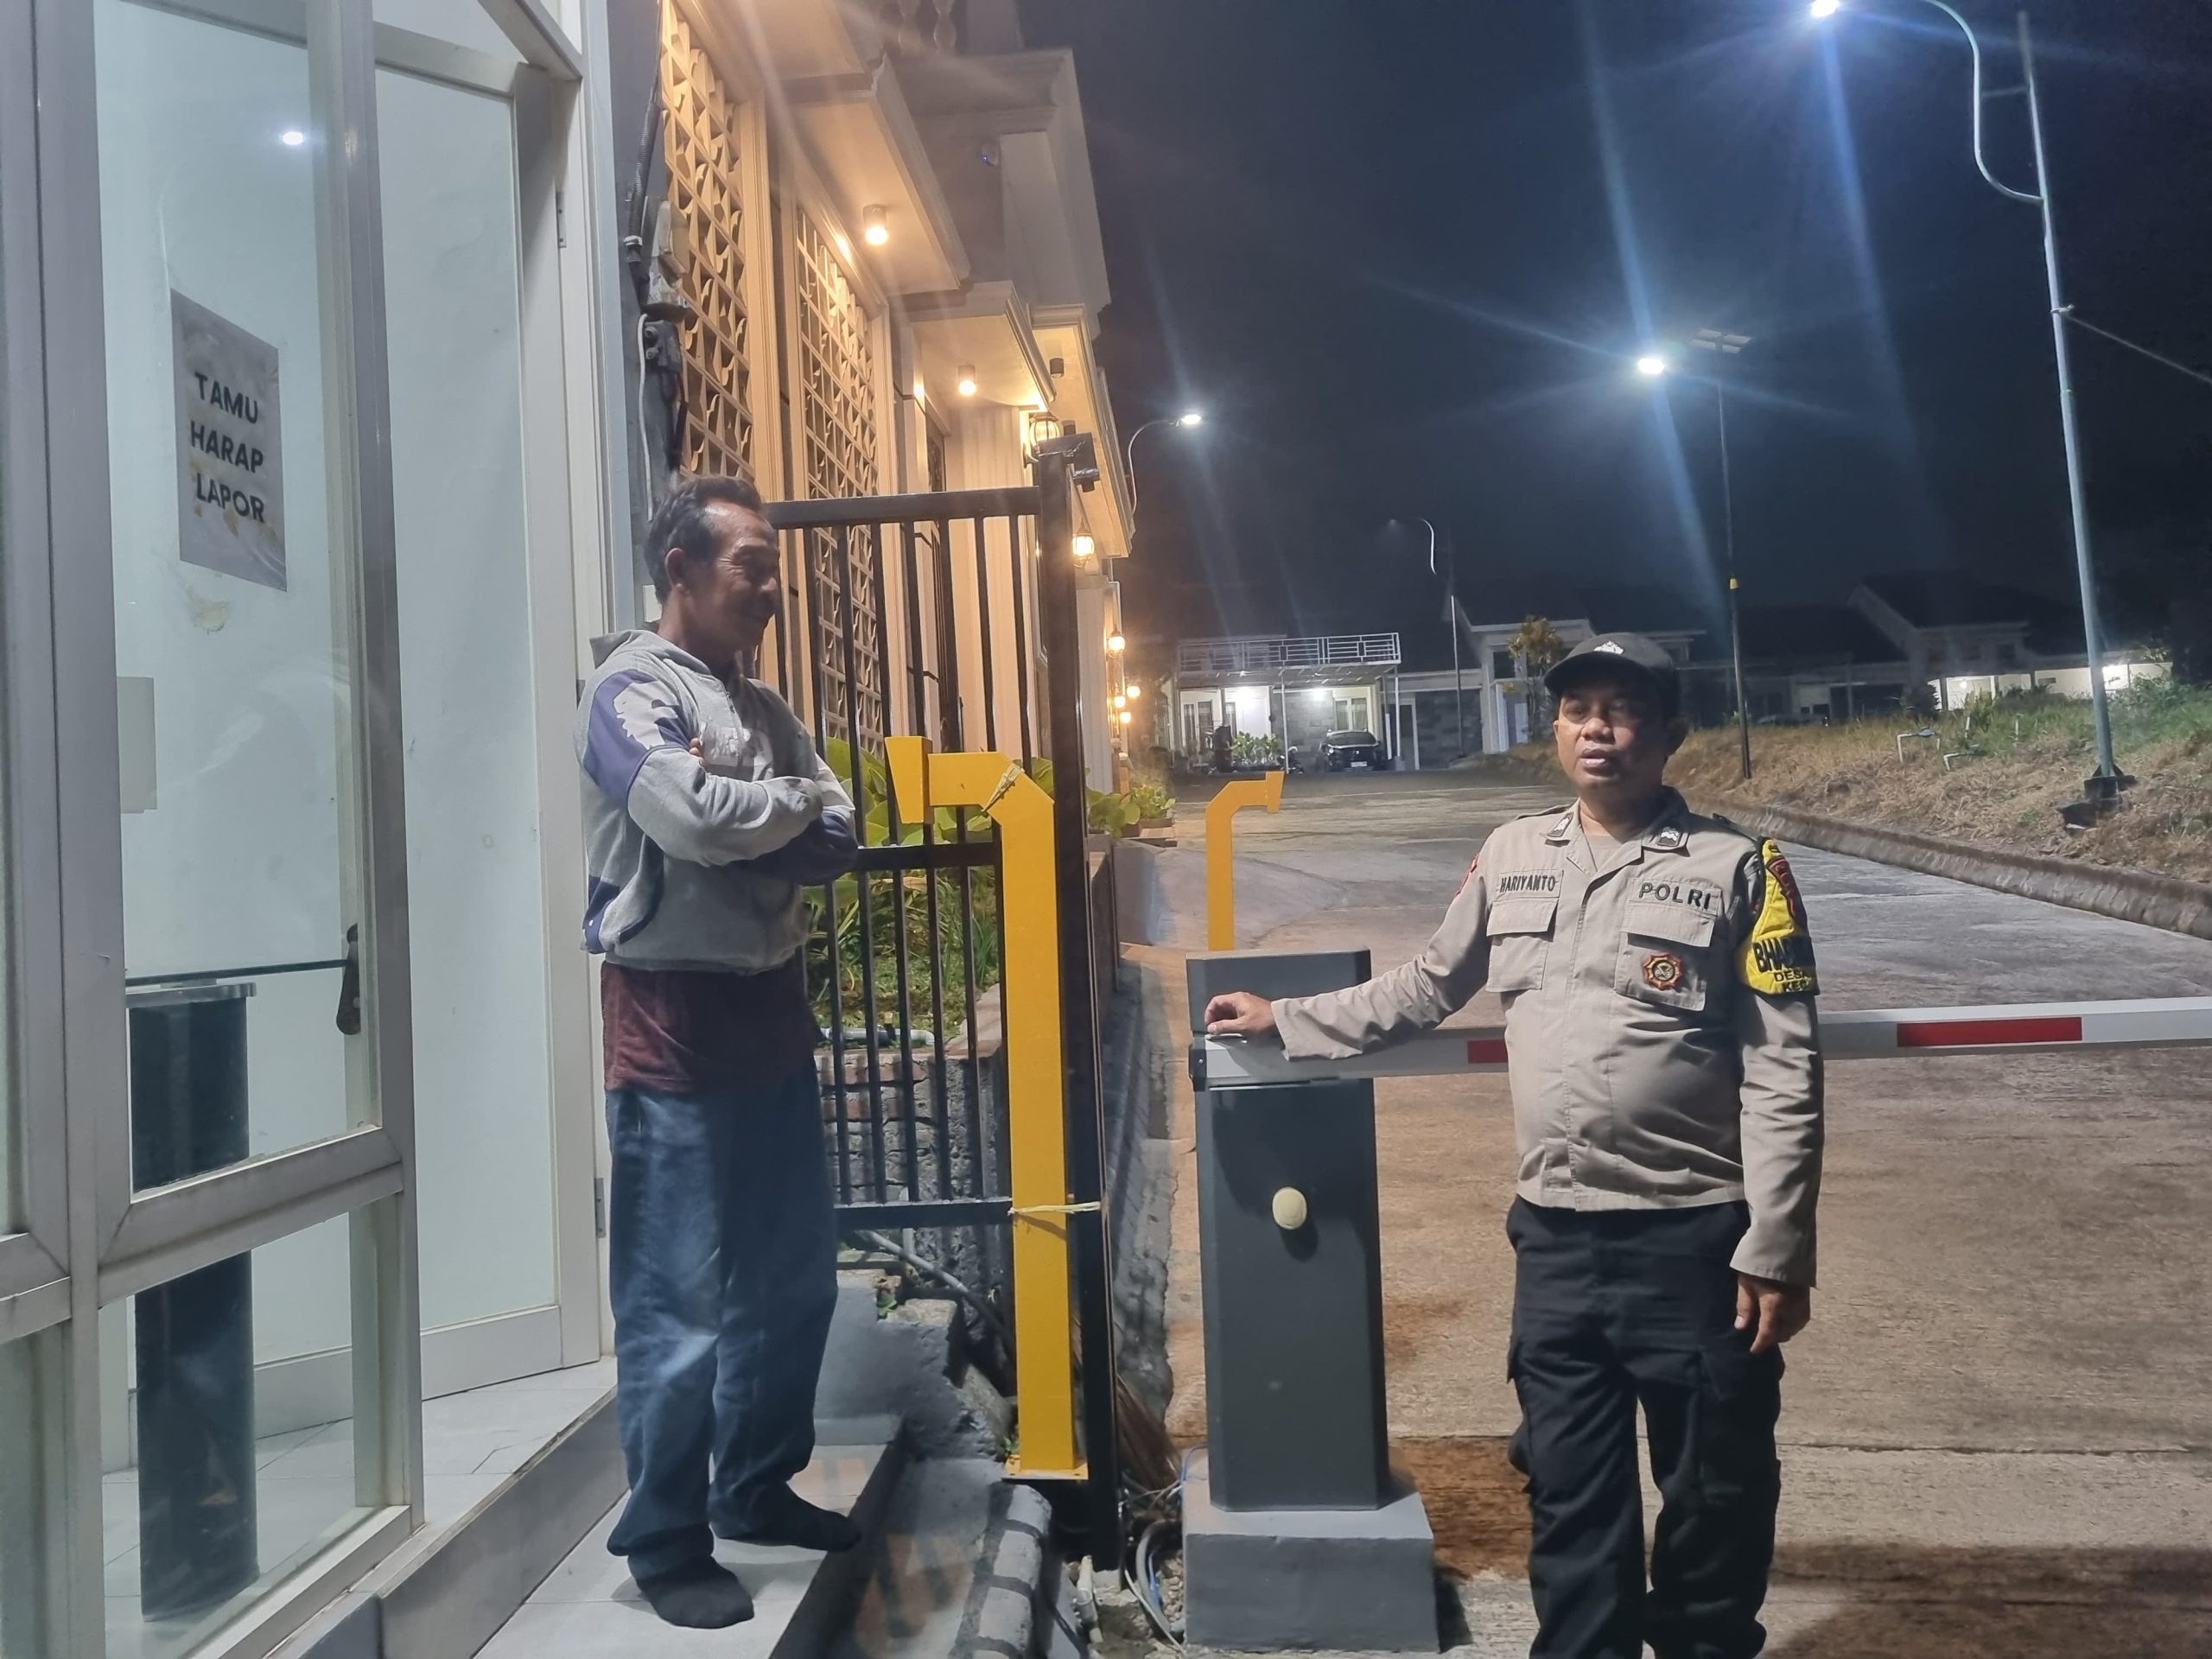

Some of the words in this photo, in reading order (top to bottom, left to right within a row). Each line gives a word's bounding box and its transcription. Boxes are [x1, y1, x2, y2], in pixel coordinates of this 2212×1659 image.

[194, 371, 258, 425] TAMU
[190, 420, 264, 474] HARAP
[196, 473, 265, 524] LAPOR
[1499, 874, 1556, 893] HARIYANTO
[1638, 882, 1711, 910] POLRI
